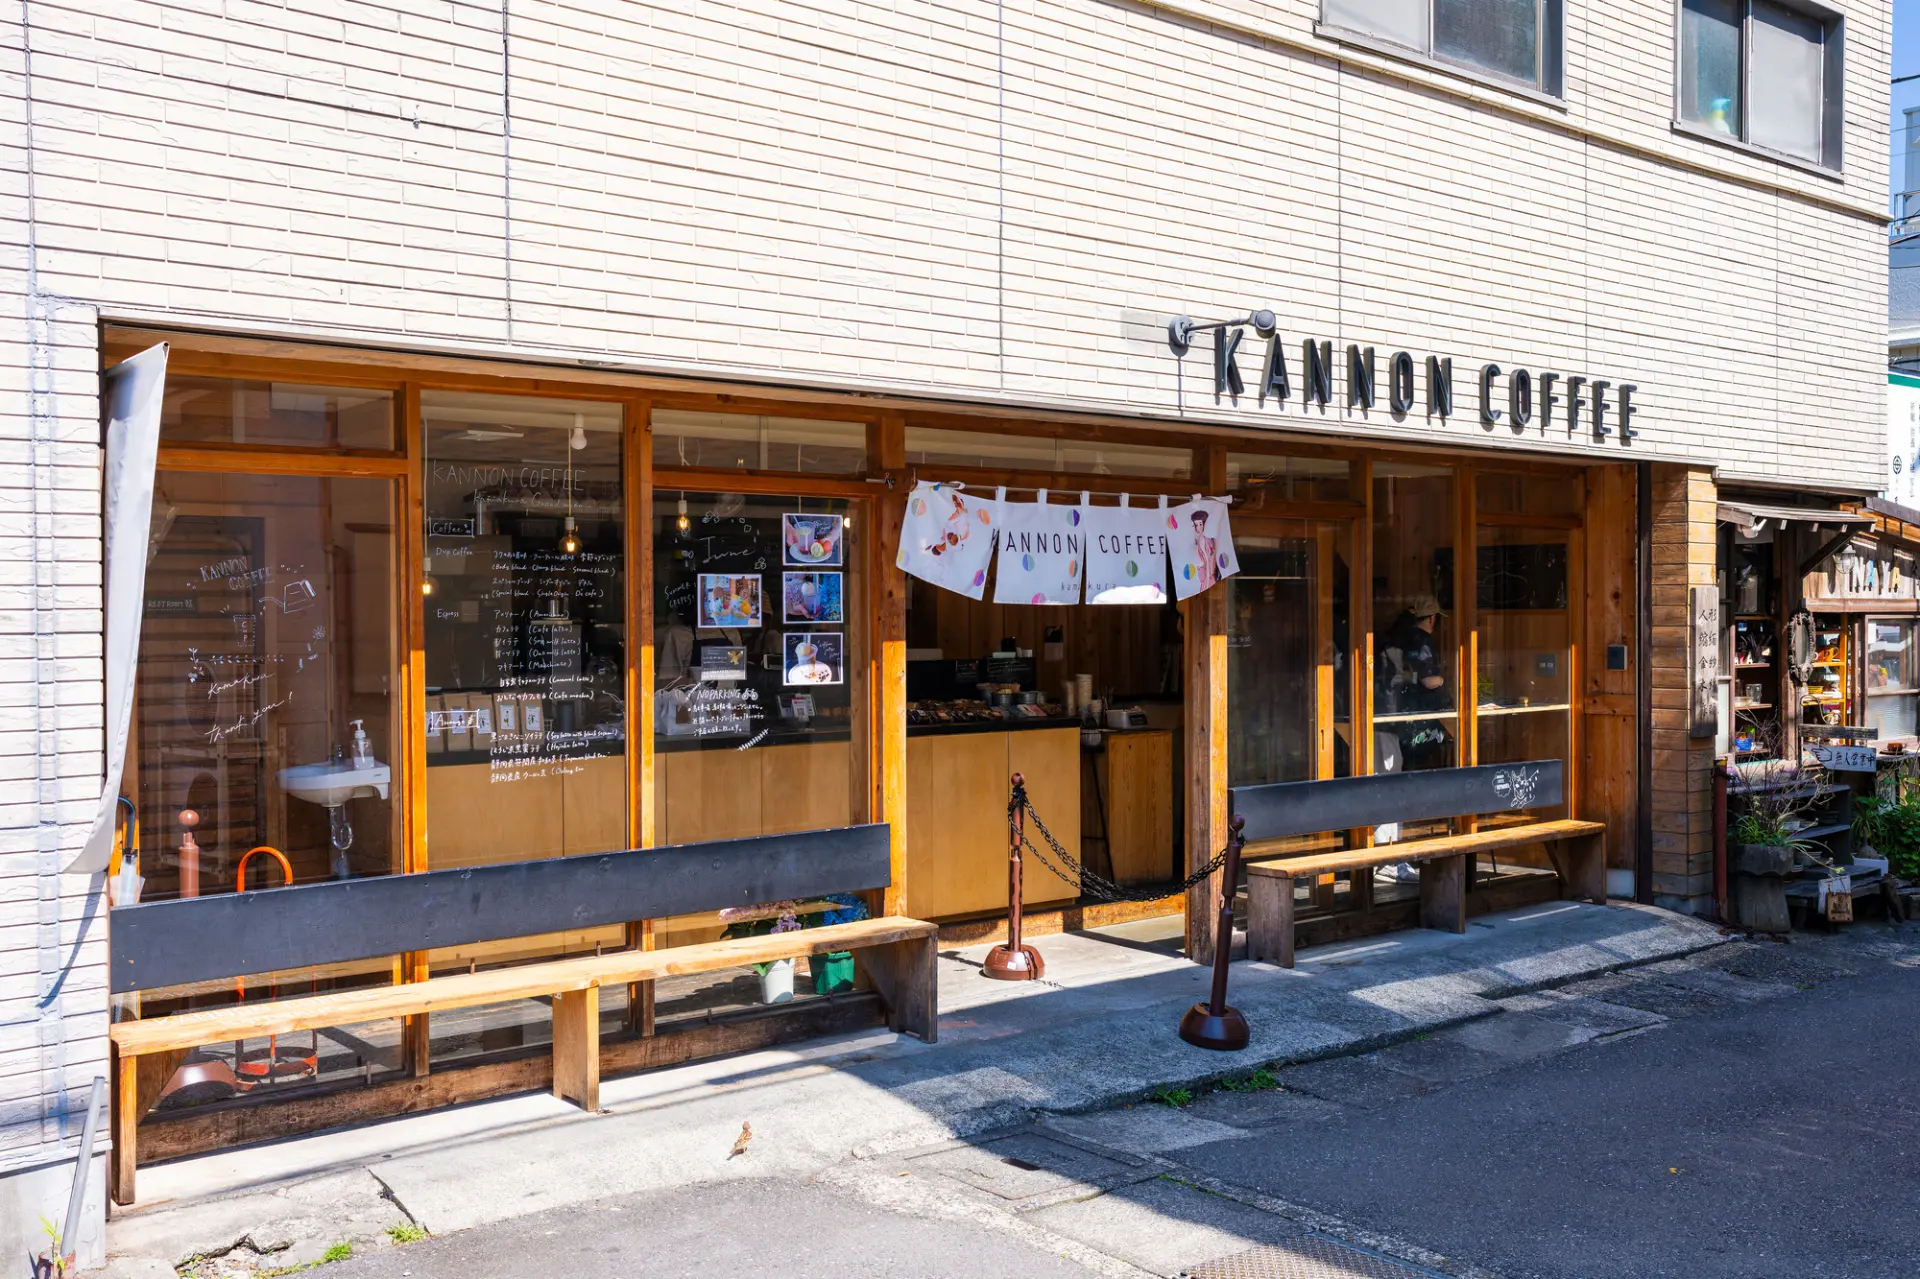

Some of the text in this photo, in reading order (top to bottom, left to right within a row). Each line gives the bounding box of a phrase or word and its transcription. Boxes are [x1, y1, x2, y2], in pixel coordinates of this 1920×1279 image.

[1214, 326, 1639, 438] KANNON COFFEE
[432, 459, 586, 491] KANNON COFFEE
[1098, 535, 1165, 554] COFFEE
[199, 556, 249, 582] KANNON
